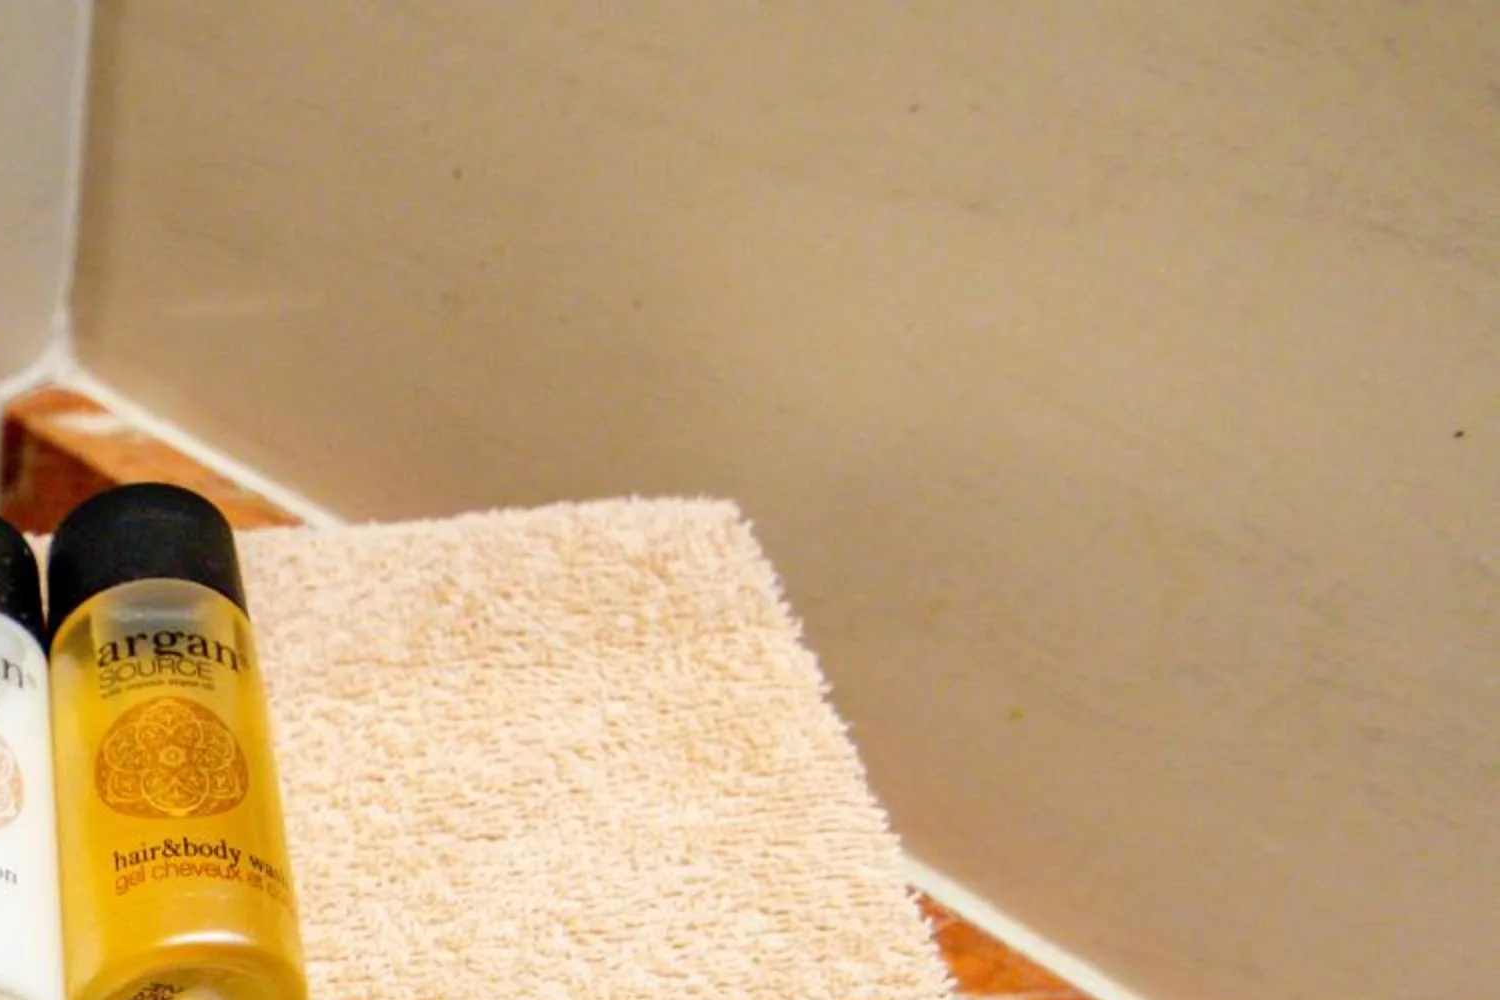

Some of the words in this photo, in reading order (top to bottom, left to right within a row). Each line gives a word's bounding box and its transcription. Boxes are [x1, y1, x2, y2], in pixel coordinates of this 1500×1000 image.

[97, 629, 240, 673] argan
[99, 657, 214, 689] SOURCE
[113, 836, 242, 872] hair&body
[115, 867, 146, 896] gel
[151, 860, 242, 883] cheveux
